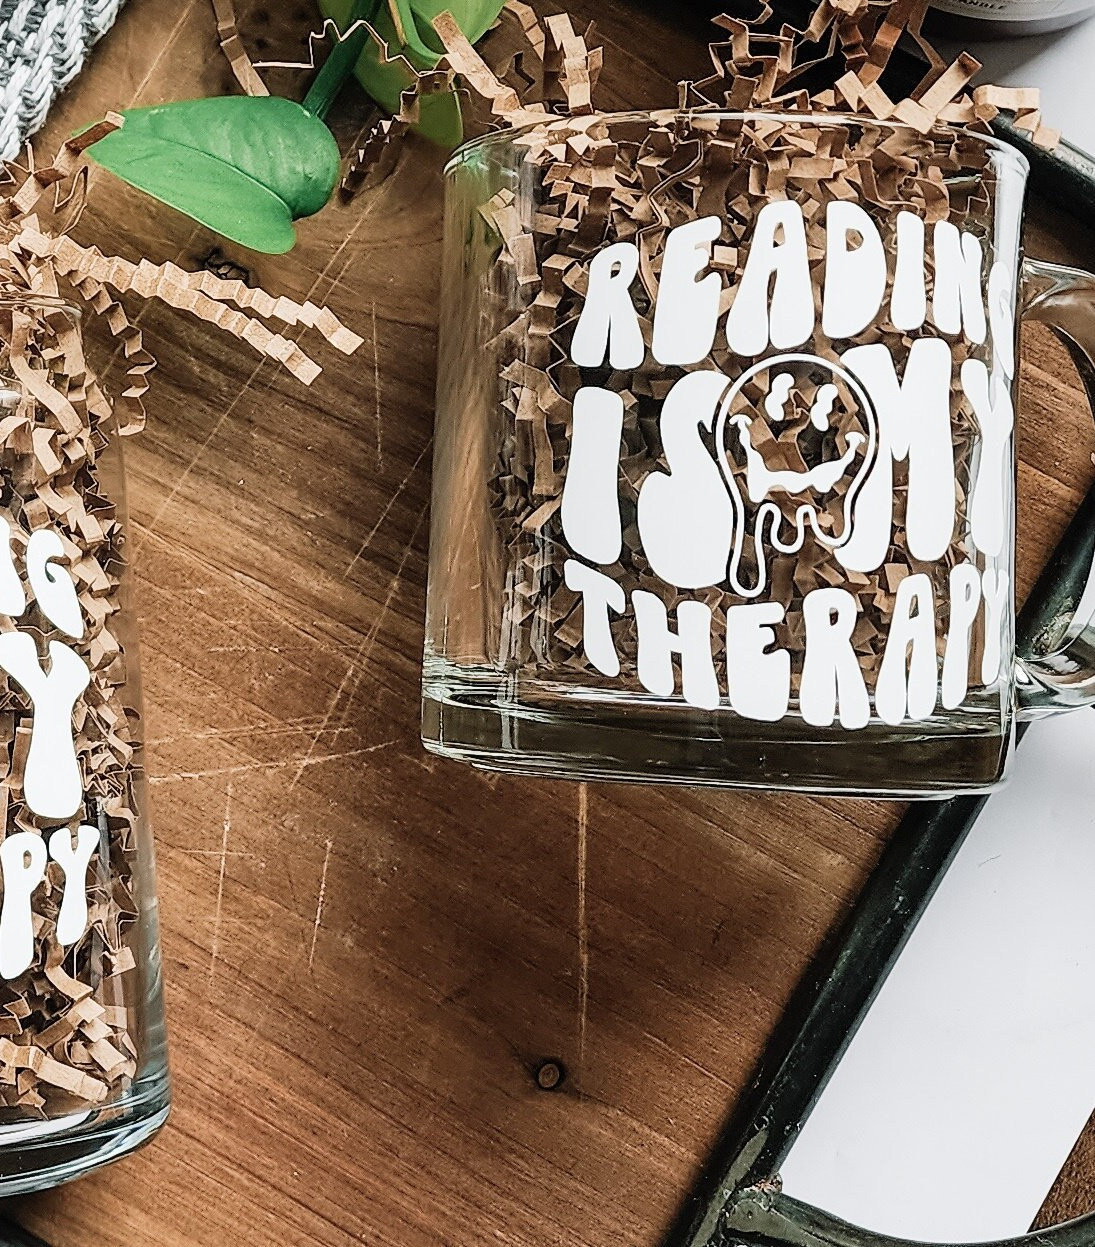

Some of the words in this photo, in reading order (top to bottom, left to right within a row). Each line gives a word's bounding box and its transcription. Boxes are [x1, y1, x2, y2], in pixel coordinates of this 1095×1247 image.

[570, 200, 1015, 381] READING
[560, 370, 736, 589] IS
[834, 337, 1014, 572] MY
[564, 558, 1010, 729] THERAPY
